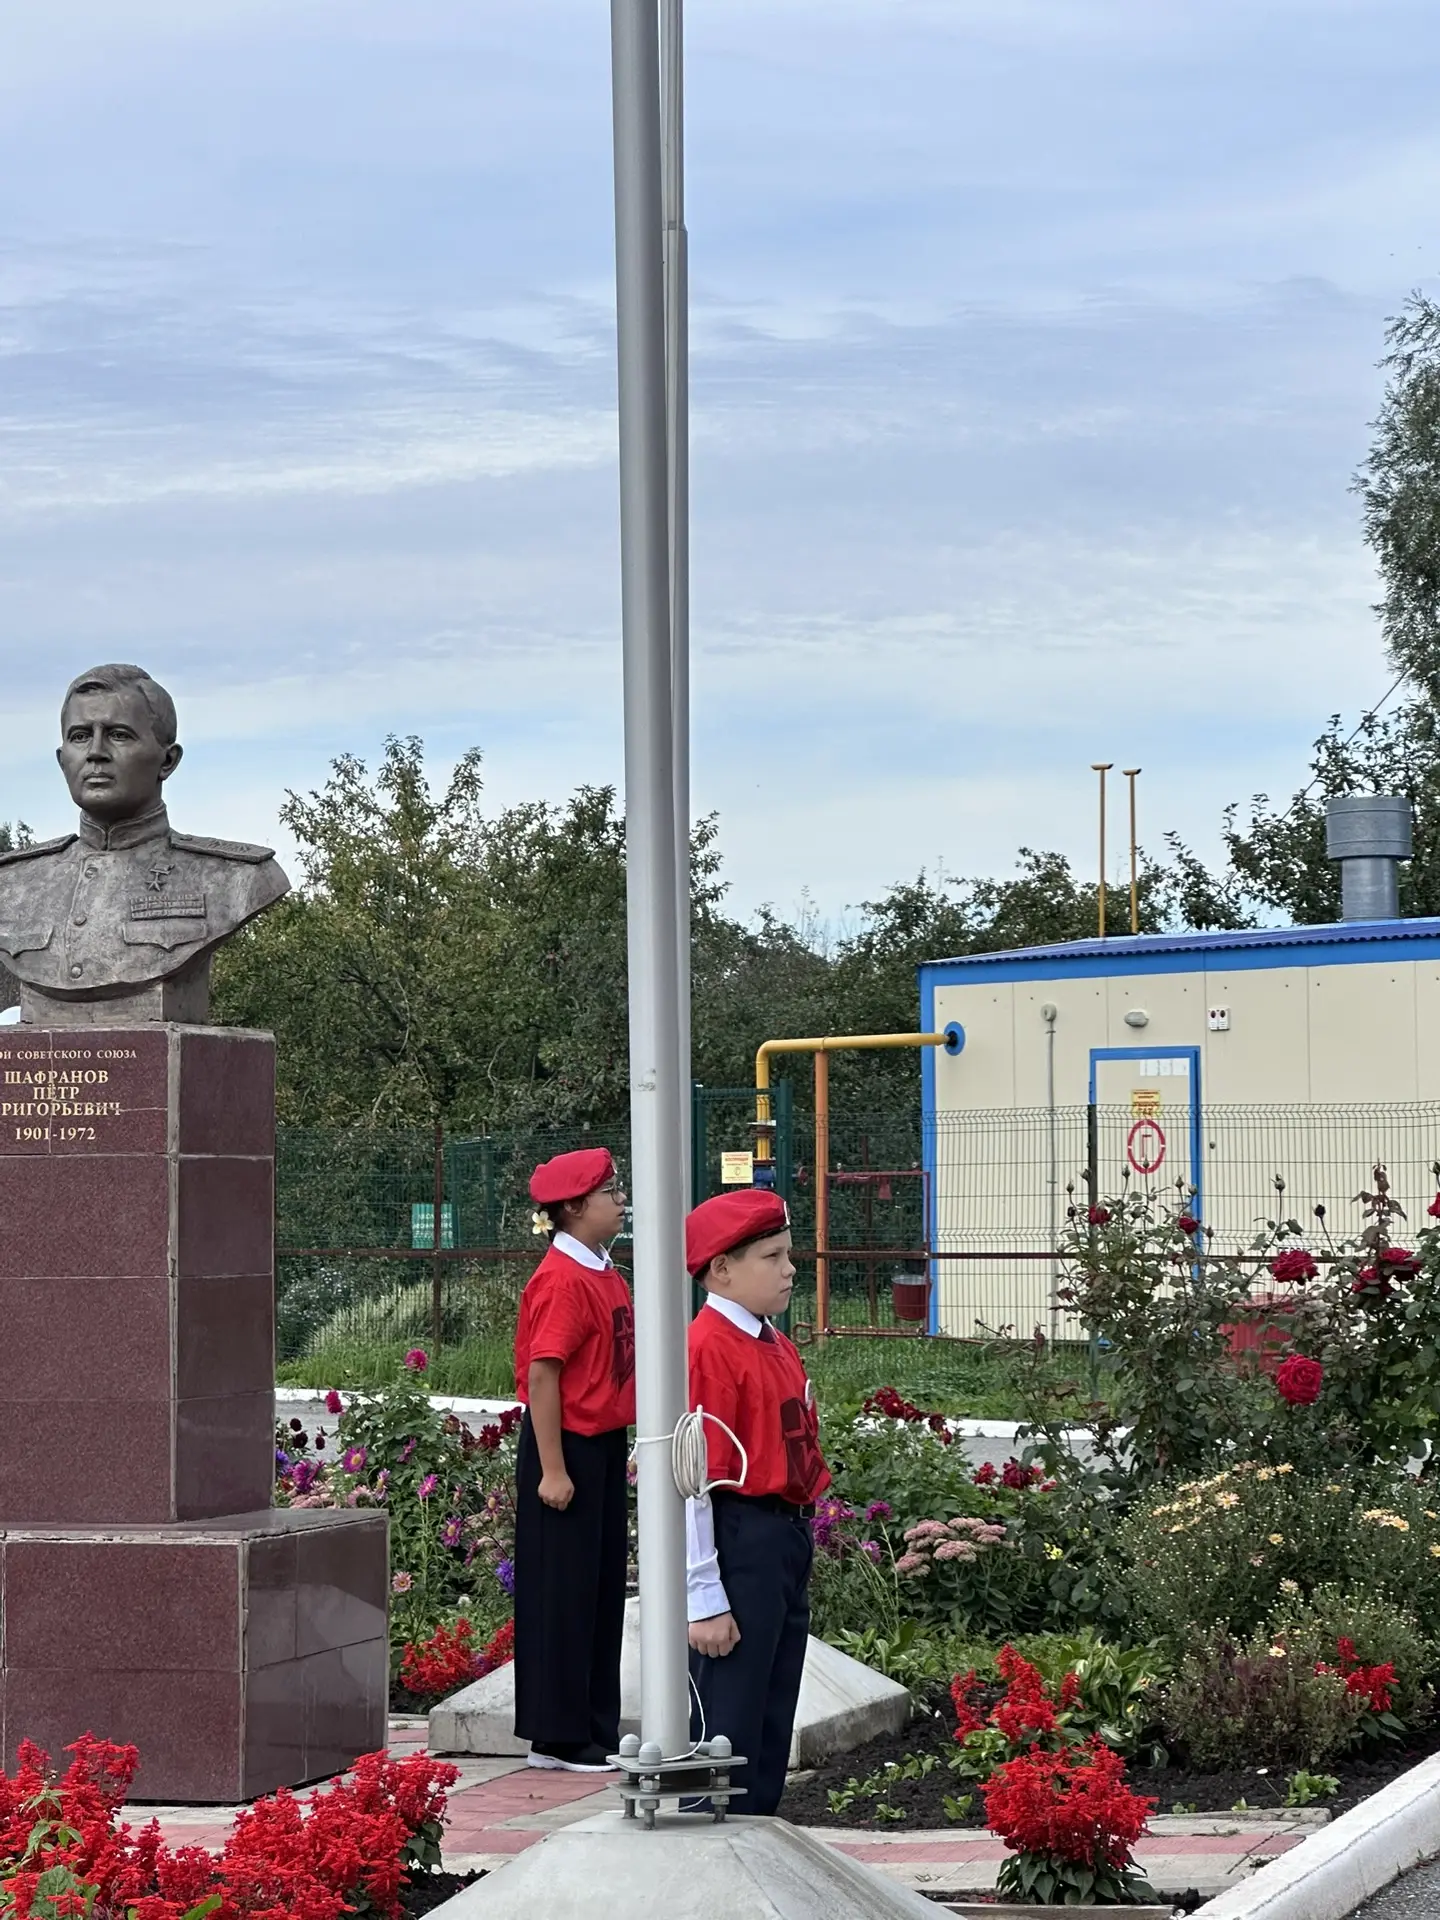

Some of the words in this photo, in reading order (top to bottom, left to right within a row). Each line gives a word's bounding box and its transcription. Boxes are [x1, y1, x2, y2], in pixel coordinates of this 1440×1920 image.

[17, 1050, 91, 1060] СОВЕТСКОГО
[97, 1050, 137, 1059] СОЮЗА
[4, 1070, 109, 1084] ШАФРАНОВ
[33, 1084, 80, 1100] ПЁТР
[15, 1127, 96, 1140] 1901-1972
